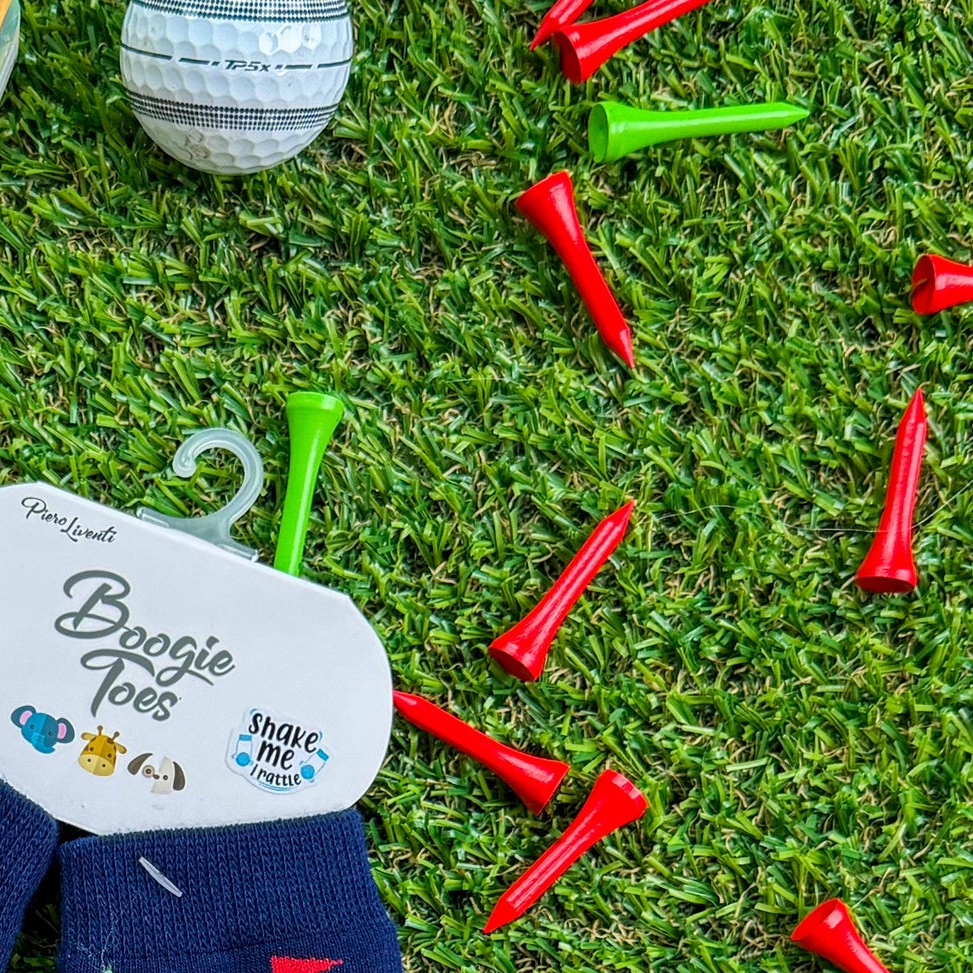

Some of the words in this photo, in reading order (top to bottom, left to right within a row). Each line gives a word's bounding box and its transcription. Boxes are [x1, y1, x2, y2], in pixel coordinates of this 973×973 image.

[225, 59, 272, 72] TP5x
[20, 496, 68, 526] Piero
[60, 516, 118, 543] Liventi
[54, 569, 236, 687] Boogie
[80, 648, 178, 722] Toes
[256, 740, 295, 771] me
[256, 768, 302, 786] rattle
